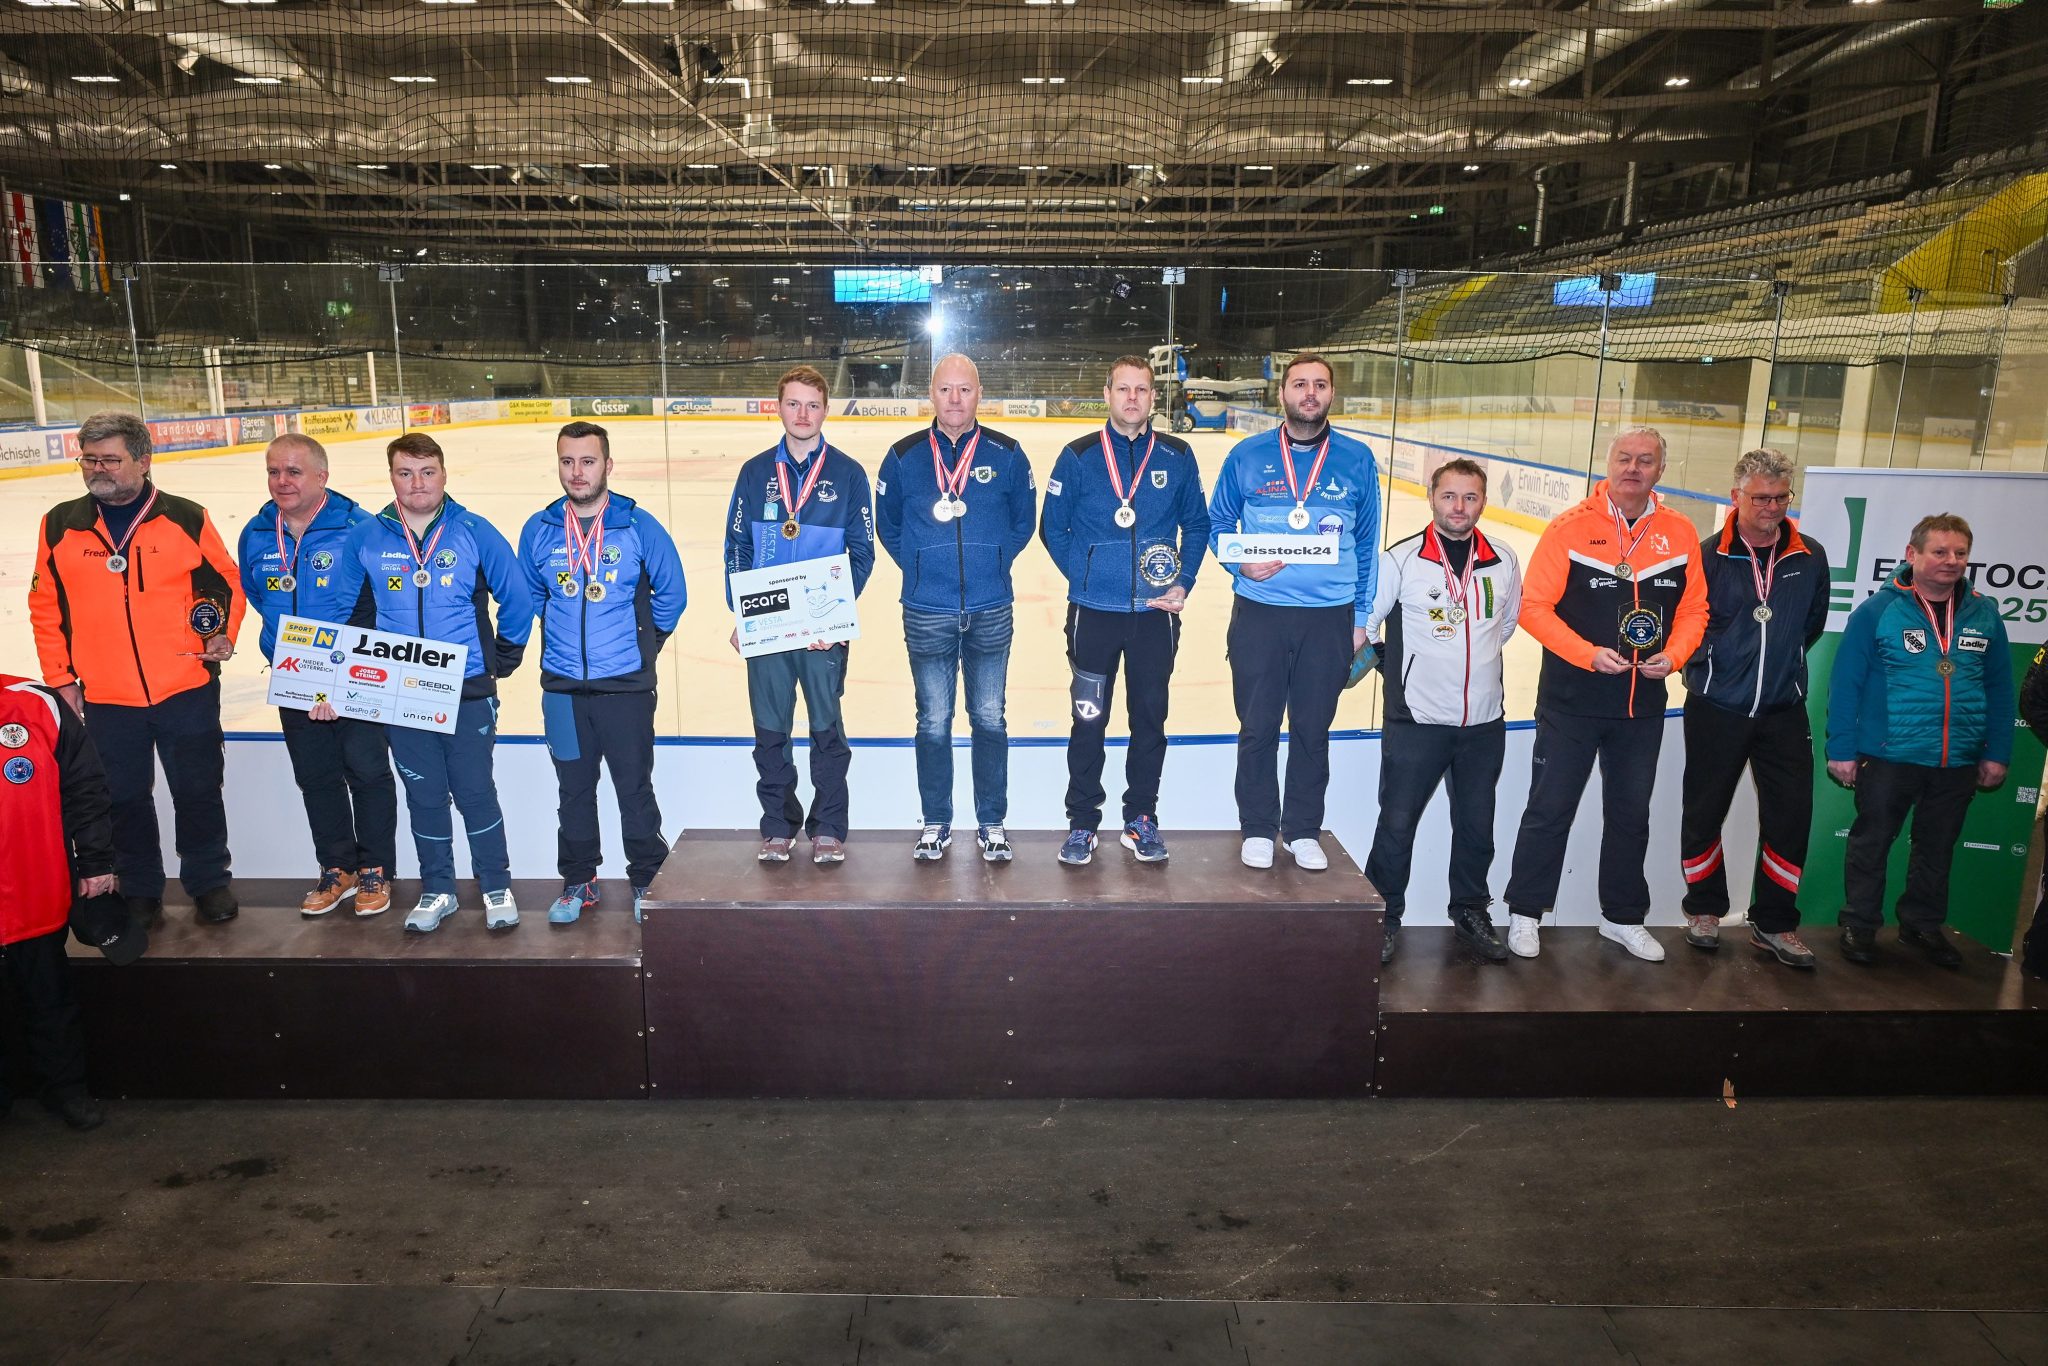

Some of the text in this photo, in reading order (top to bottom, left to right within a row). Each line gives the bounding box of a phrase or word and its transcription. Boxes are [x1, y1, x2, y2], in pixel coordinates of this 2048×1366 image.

[592, 399, 630, 415] Gösser
[862, 405, 907, 416] BÖHLER
[241, 416, 265, 427] Glaserei
[242, 428, 263, 439] Gruber
[0, 445, 41, 462] ichische
[1518, 467, 1570, 500] Erwin Fuchs
[1255, 485, 1288, 494] ALINA
[861, 506, 874, 542] pcare
[767, 524, 777, 561] VESTA
[83, 549, 109, 557] Fredi
[381, 551, 411, 560] Ladler
[1244, 546, 1332, 555] eisstock24
[768, 575, 799, 585] sponsored
[741, 592, 788, 615] pcare
[289, 624, 313, 633] SPORT
[287, 635, 308, 643] LAND
[1959, 640, 1986, 649] Ladler
[352, 634, 456, 668] Ladler
[276, 656, 301, 673] AK
[298, 662, 334, 673] ÖSTERREICH
[302, 658, 324, 666] NIEDER
[355, 671, 381, 680] STEINER
[418, 680, 456, 691] GEBOL
[344, 705, 369, 715] GlasPro
[403, 712, 433, 722] union
